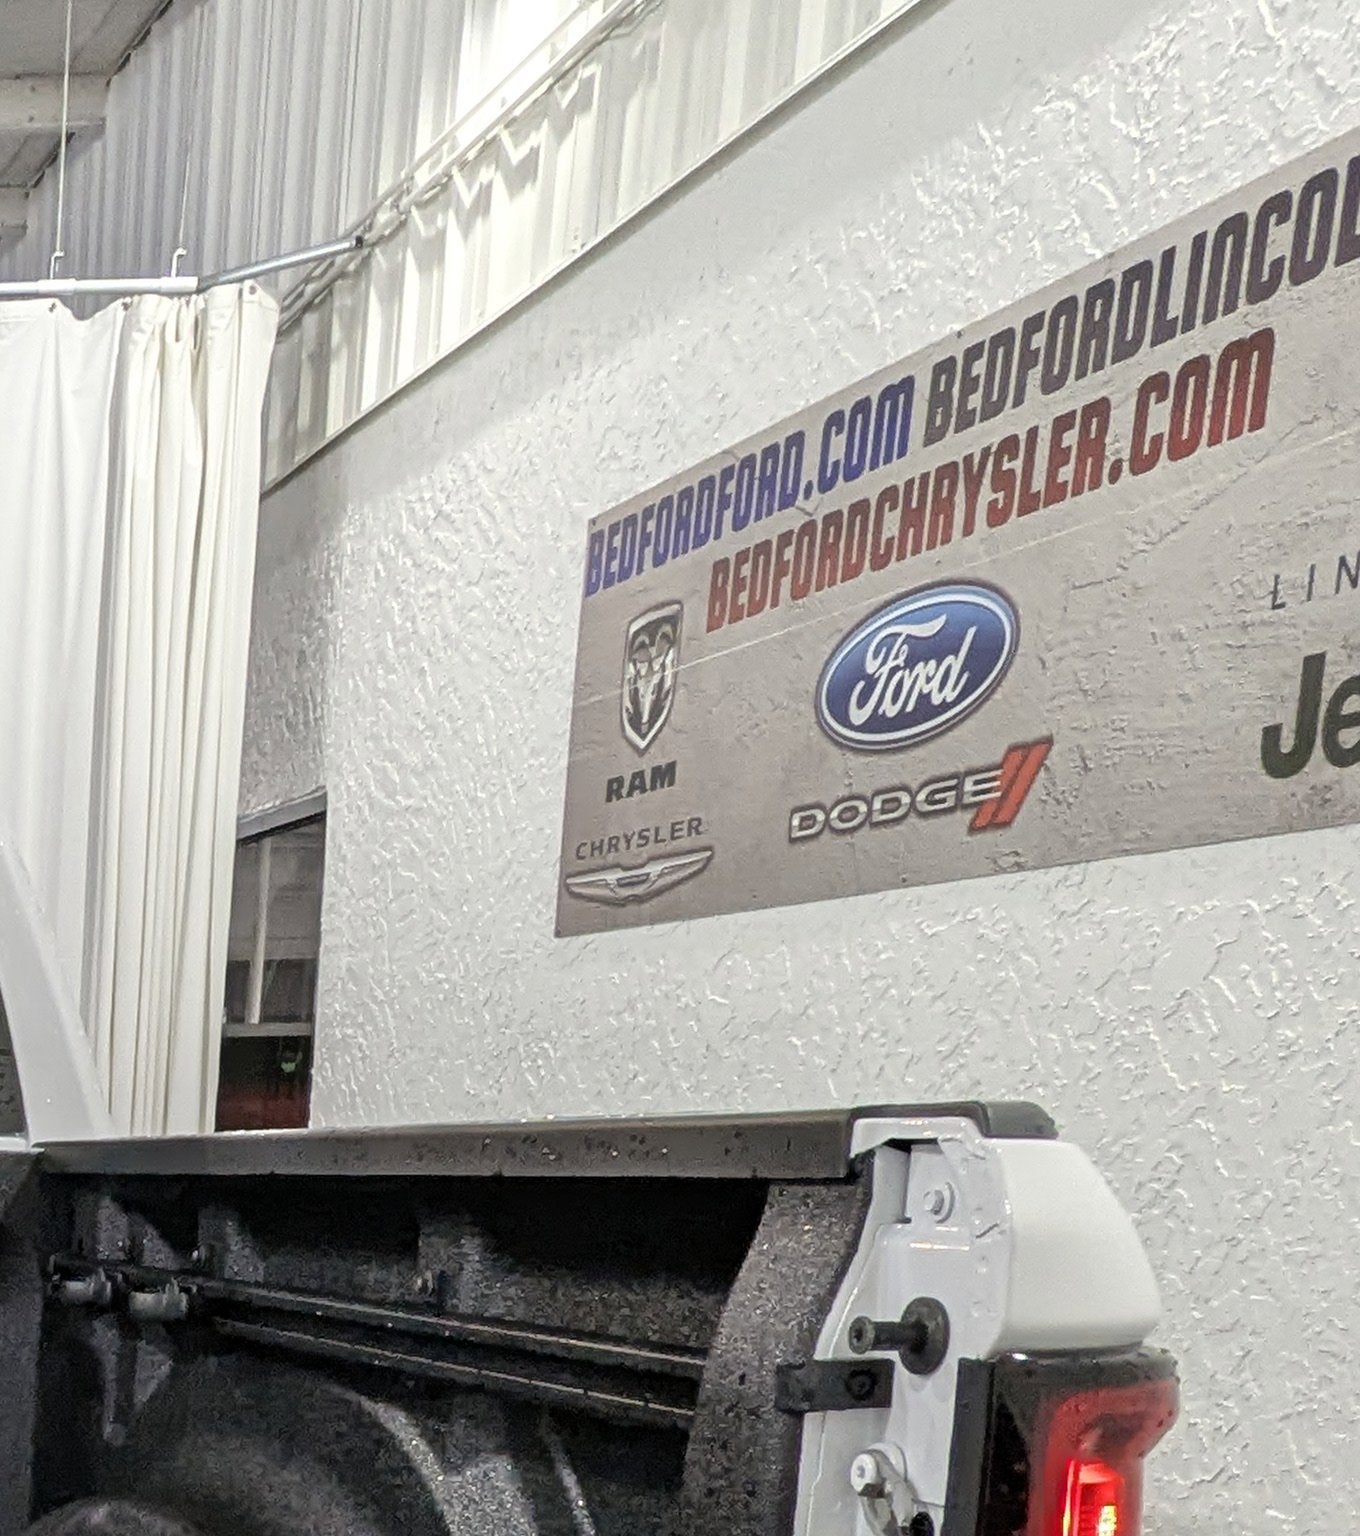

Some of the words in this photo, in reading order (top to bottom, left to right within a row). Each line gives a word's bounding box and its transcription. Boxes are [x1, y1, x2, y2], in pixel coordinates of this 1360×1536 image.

[585, 374, 916, 598] BEDFORDFORD.COM
[705, 326, 1275, 634] BEDFORDCHRYSLER.COM
[848, 612, 978, 727] Ford
[605, 760, 678, 804] RAM
[788, 767, 1004, 843] DODGE
[576, 816, 704, 861] CHRYSLER
